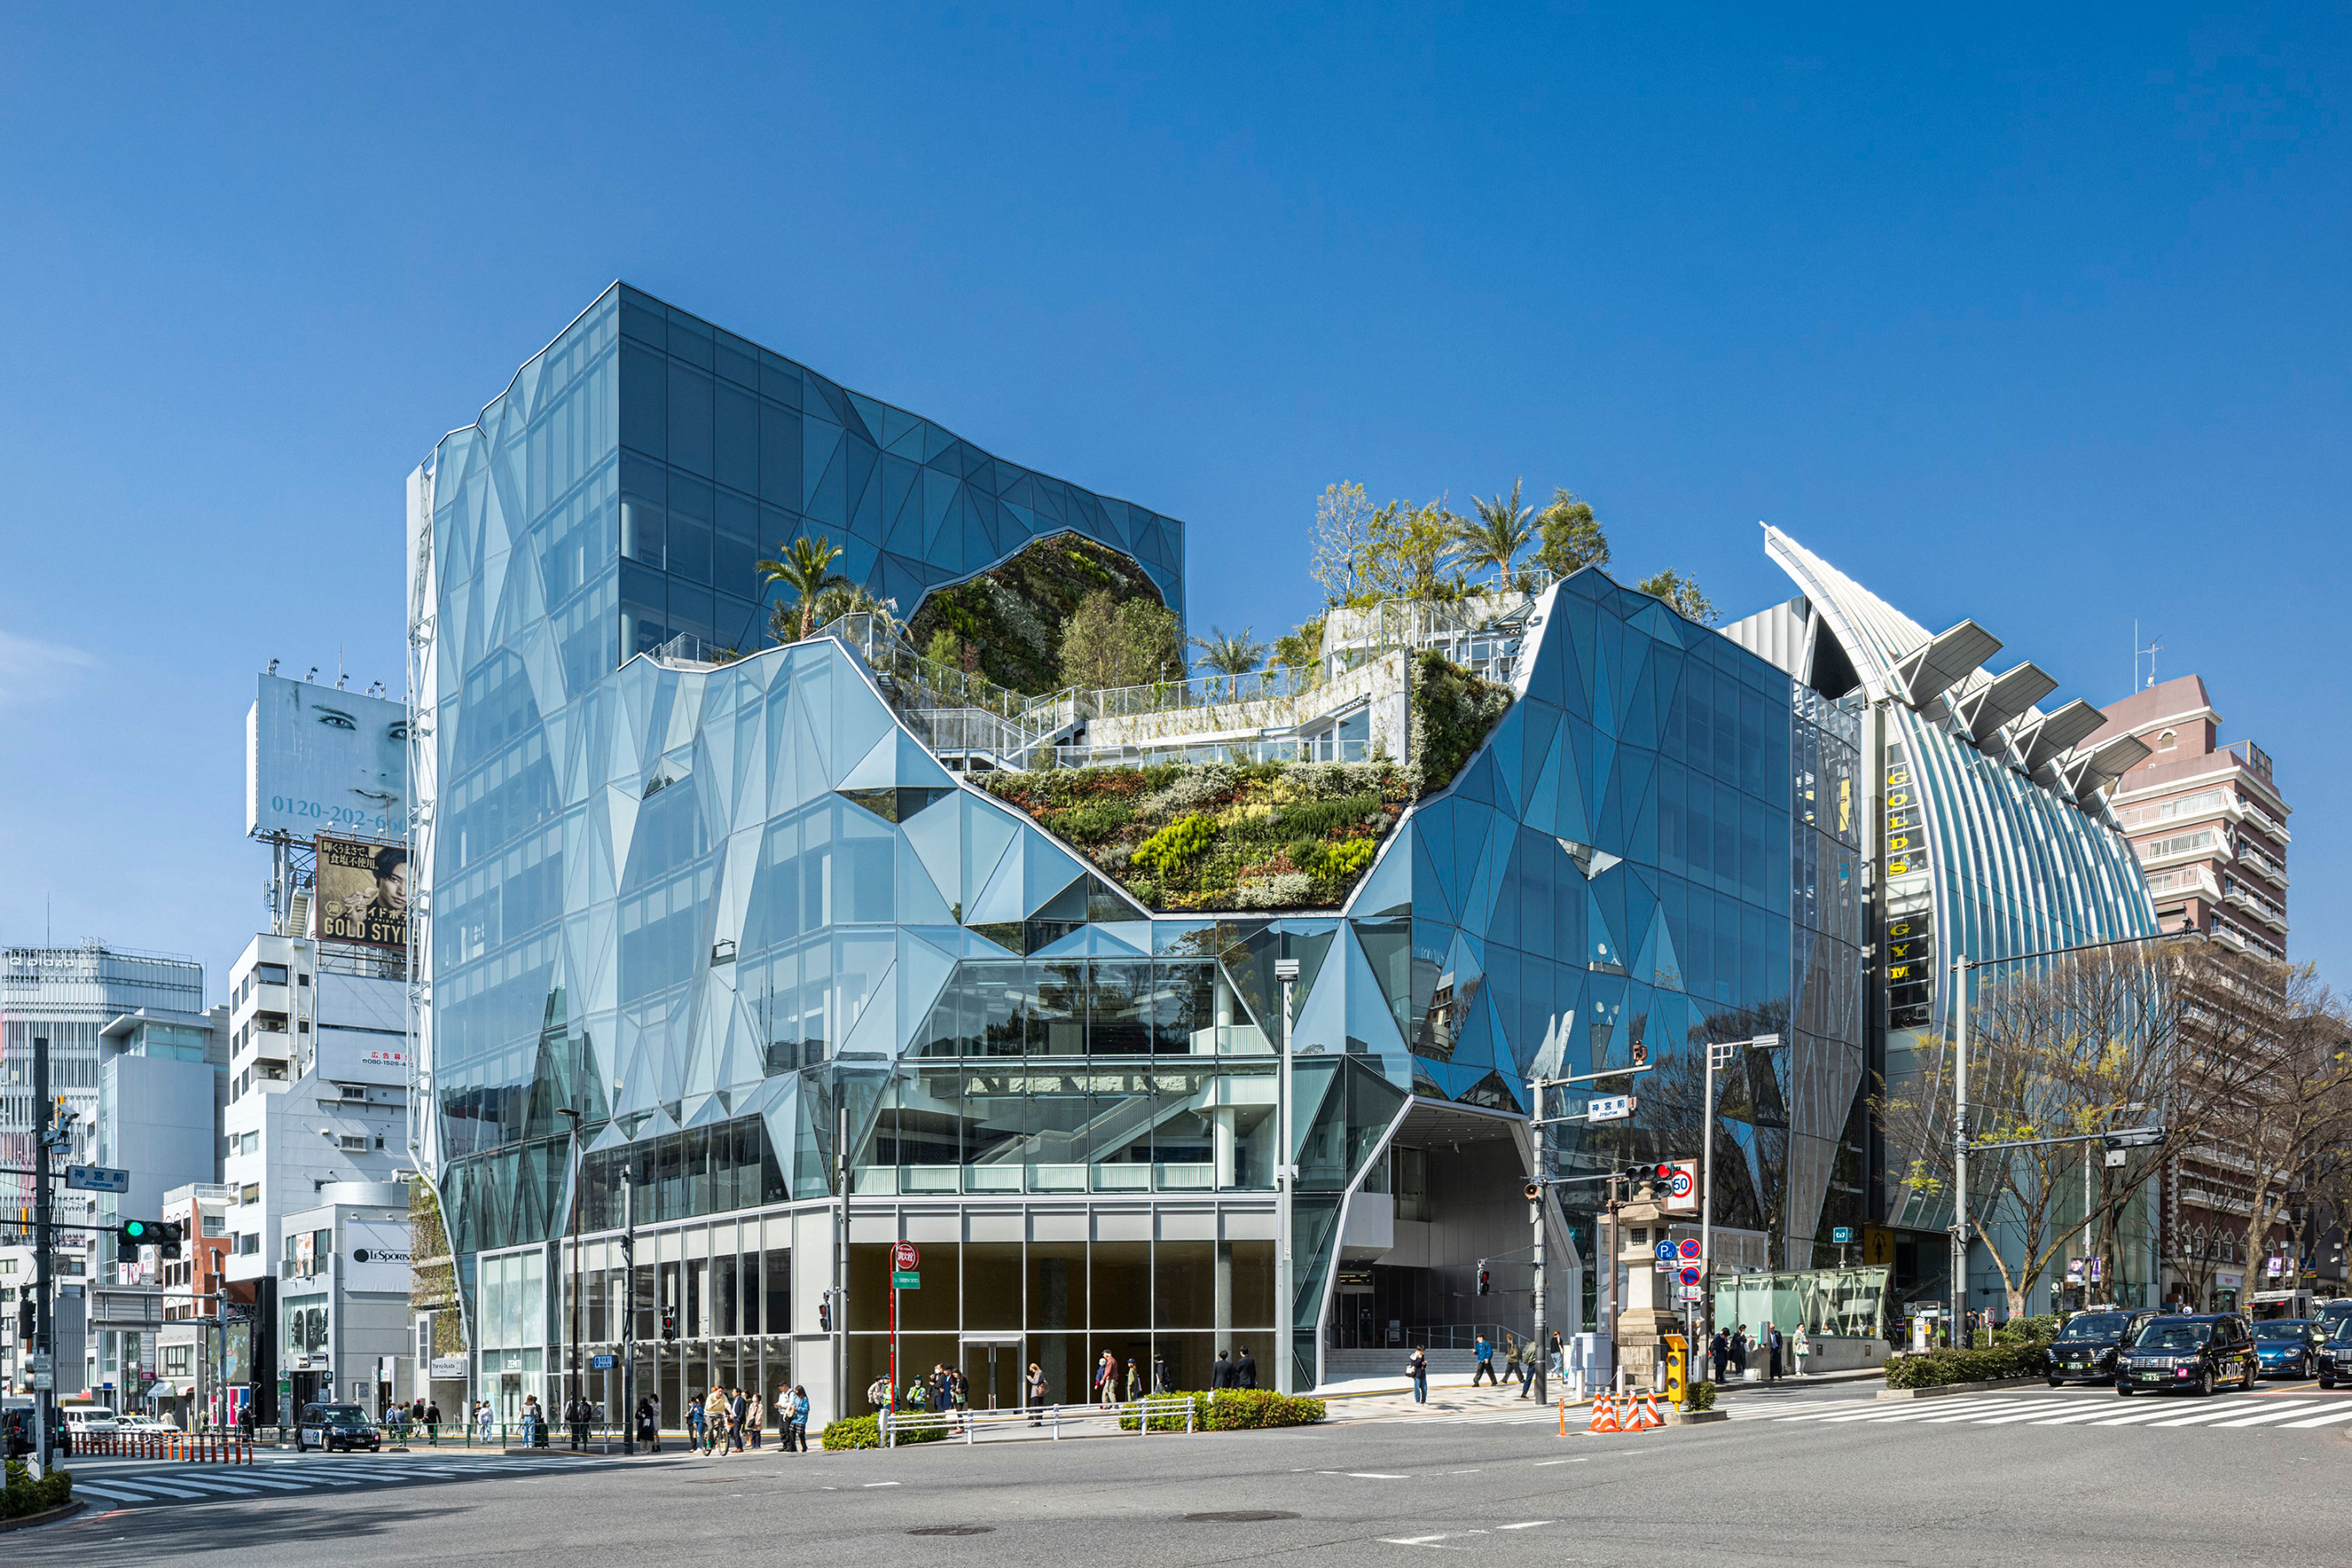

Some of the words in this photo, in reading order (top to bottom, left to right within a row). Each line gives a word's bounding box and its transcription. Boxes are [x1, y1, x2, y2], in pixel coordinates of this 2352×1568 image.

[331, 853, 379, 870] 食塩不使用。
[324, 917, 366, 939] GOLD
[1890, 924, 1911, 979] GYM
[1592, 1099, 1624, 1112] 神宮前
[74, 1169, 124, 1182] 神宮前
[1673, 1177, 1688, 1191] 50
[1660, 1245, 1669, 1258] P
